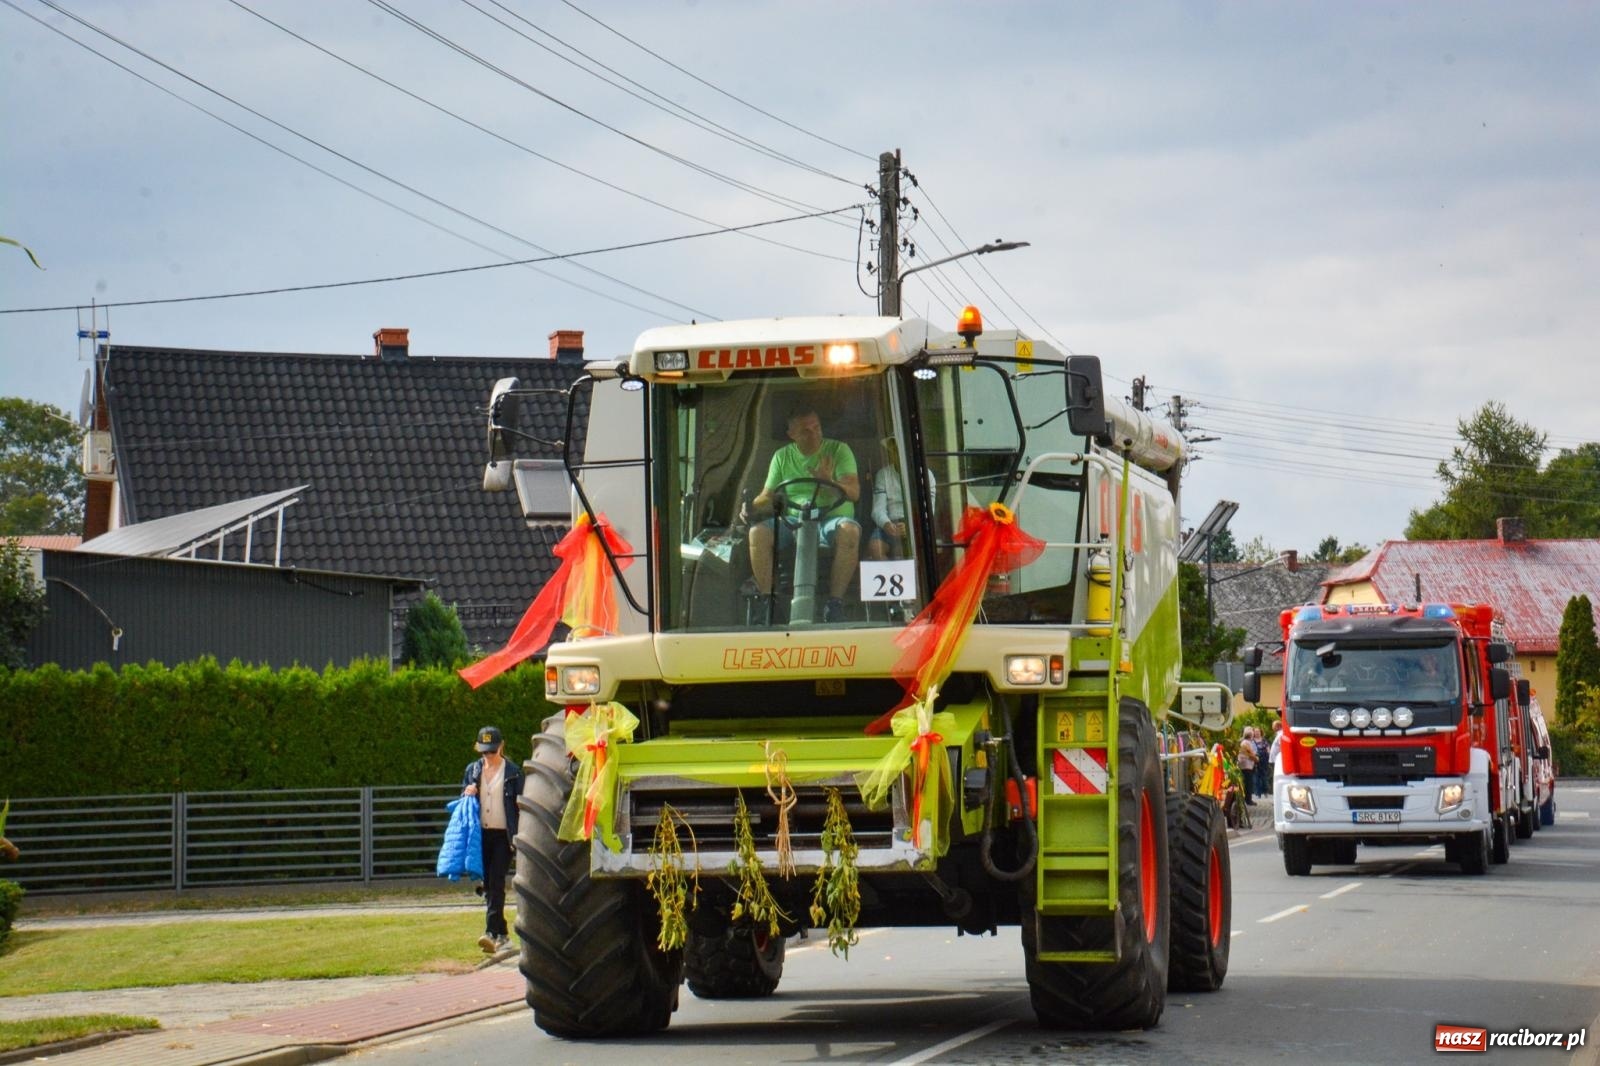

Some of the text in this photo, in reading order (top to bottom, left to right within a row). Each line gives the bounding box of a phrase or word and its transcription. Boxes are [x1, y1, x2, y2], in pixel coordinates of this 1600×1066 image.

[697, 345, 815, 369] CLAAS
[873, 574, 904, 597] 28
[723, 645, 857, 670] LEXION
[1358, 811, 1376, 821] SRC
